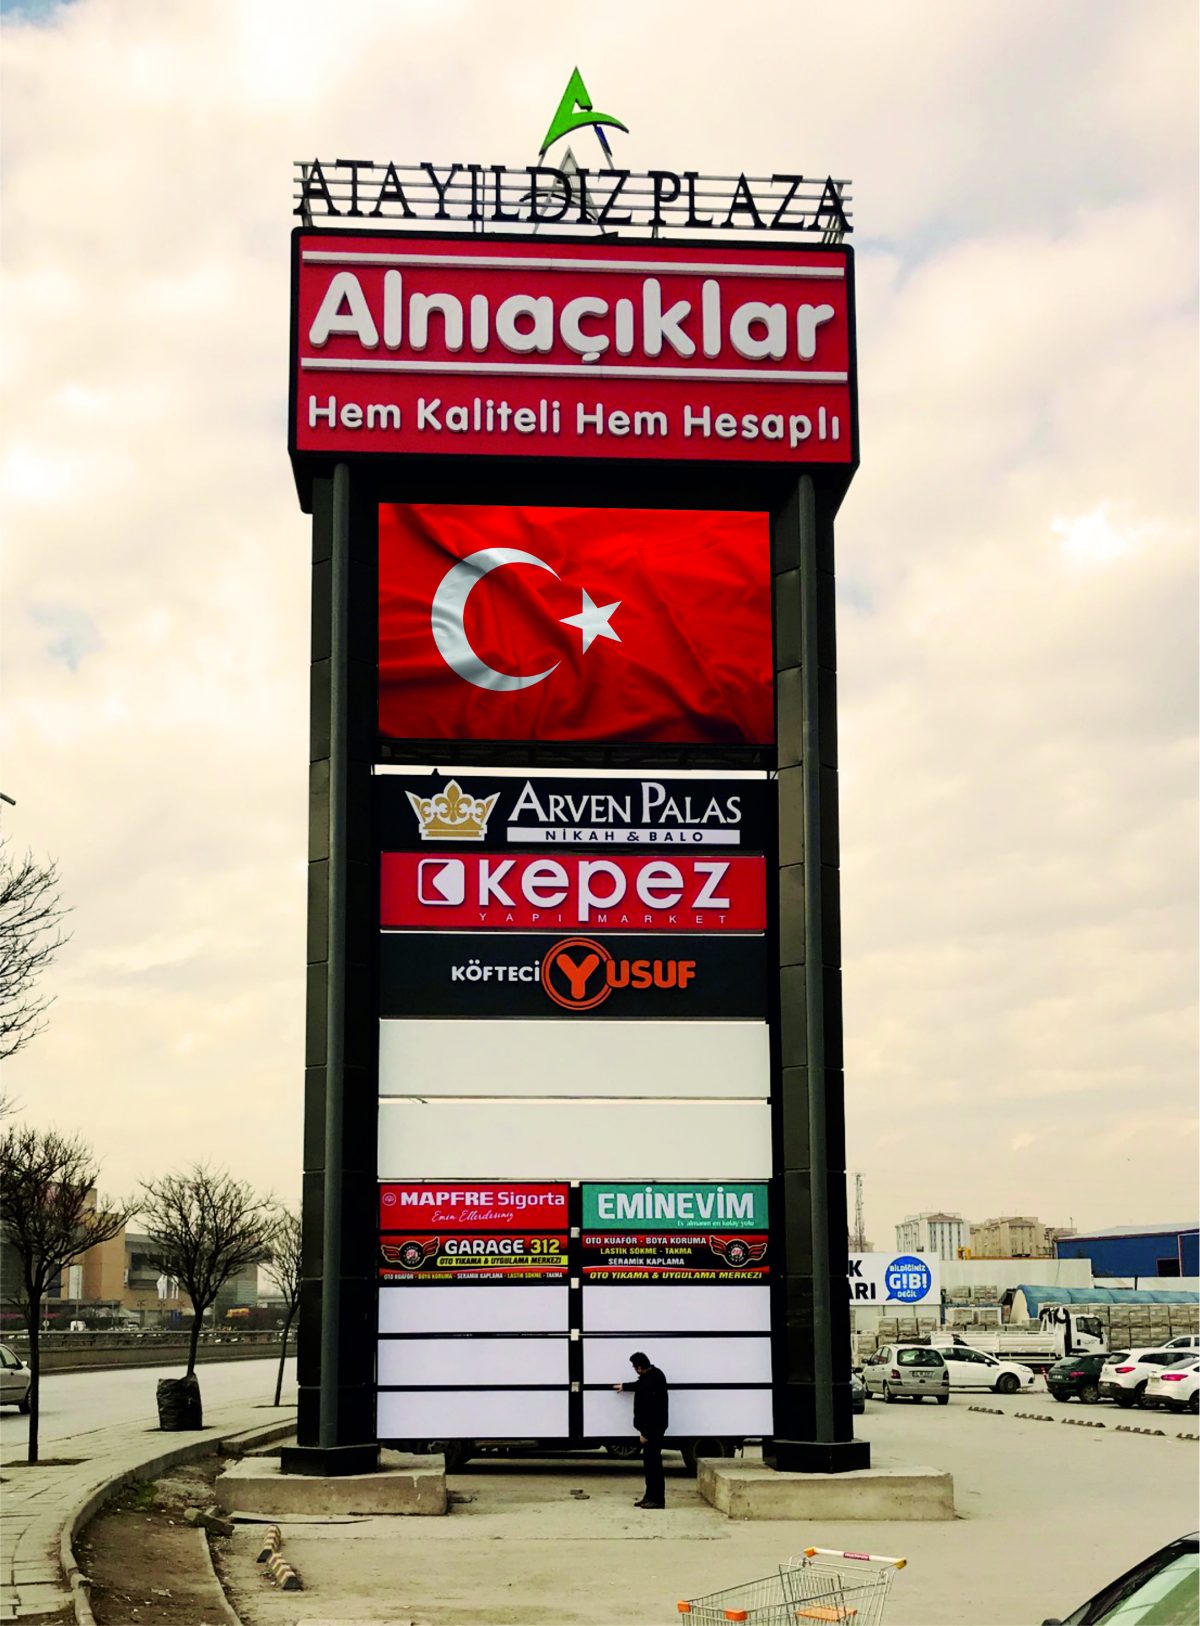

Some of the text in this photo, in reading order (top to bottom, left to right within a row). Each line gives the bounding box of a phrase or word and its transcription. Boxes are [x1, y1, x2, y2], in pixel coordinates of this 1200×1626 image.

[293, 158, 853, 233] ATAYILDIZ PLAZA
[309, 270, 835, 363] Alnıaçıklar
[309, 395, 840, 448] Hem Kaliteli Hem Hesaplı
[507, 780, 742, 825] ARVEN PALAS
[545, 828, 703, 843] NİKAH & BALO
[479, 912, 727, 924] YAPI MARKET
[450, 959, 540, 982] KÖFTECİ
[400, 1191, 565, 1209] MAPFRE Sigorta
[598, 1186, 753, 1219] EMİNEVİM
[444, 1239, 560, 1254] GARAGE 312
[665, 1247, 692, 1255] TAKMA
[440, 1257, 453, 1265] OTO
